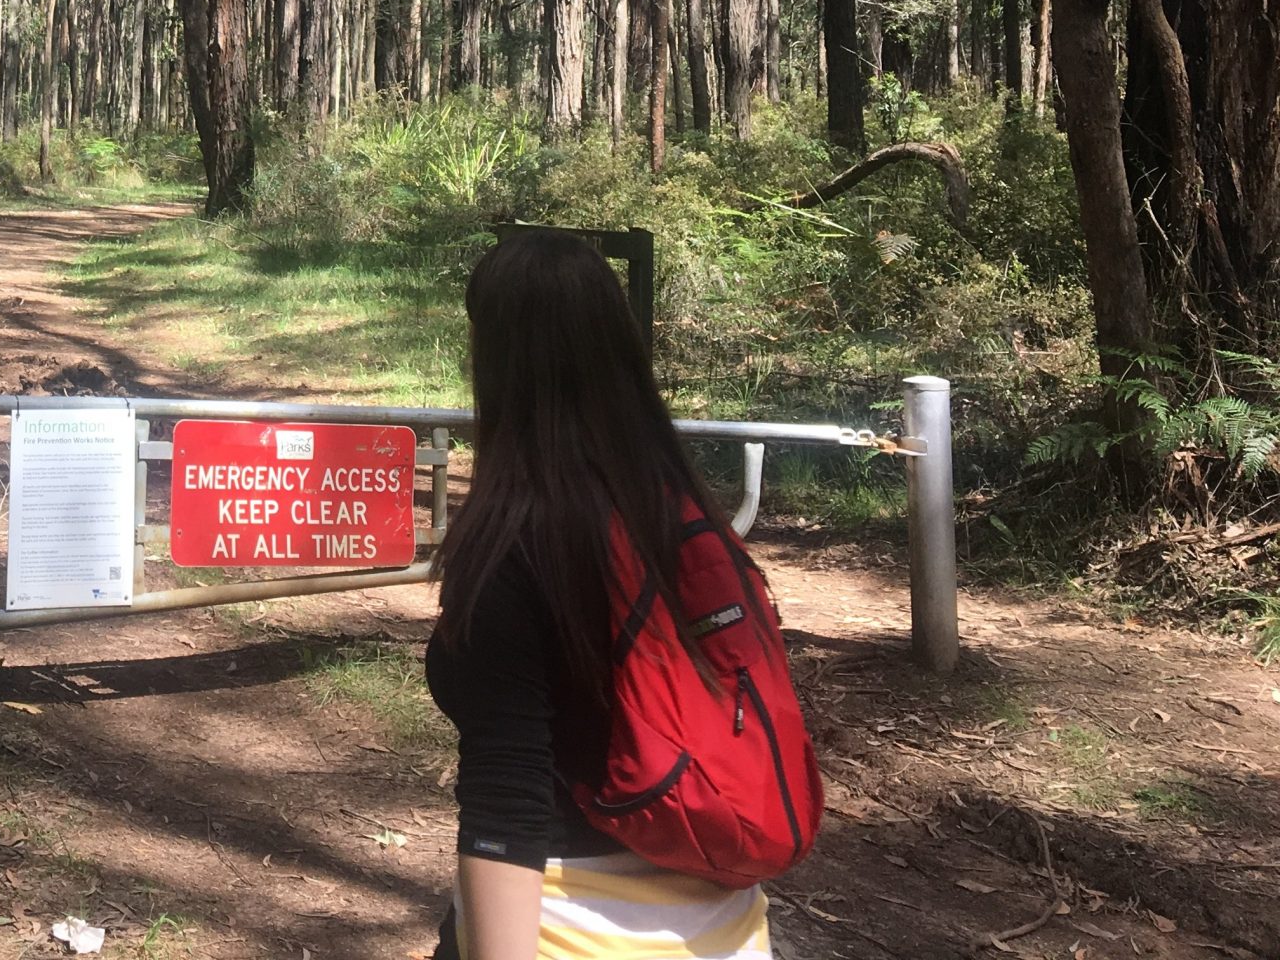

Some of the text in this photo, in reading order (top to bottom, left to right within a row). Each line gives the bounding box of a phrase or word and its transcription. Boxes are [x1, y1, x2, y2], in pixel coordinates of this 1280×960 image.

[24, 419, 105, 433] Information
[94, 436, 115, 444] Notice
[184, 465, 401, 493] EMERGENCY ACCESS
[219, 499, 367, 525] KEEP CLEAR
[212, 534, 377, 559] AT ALL TIMES
